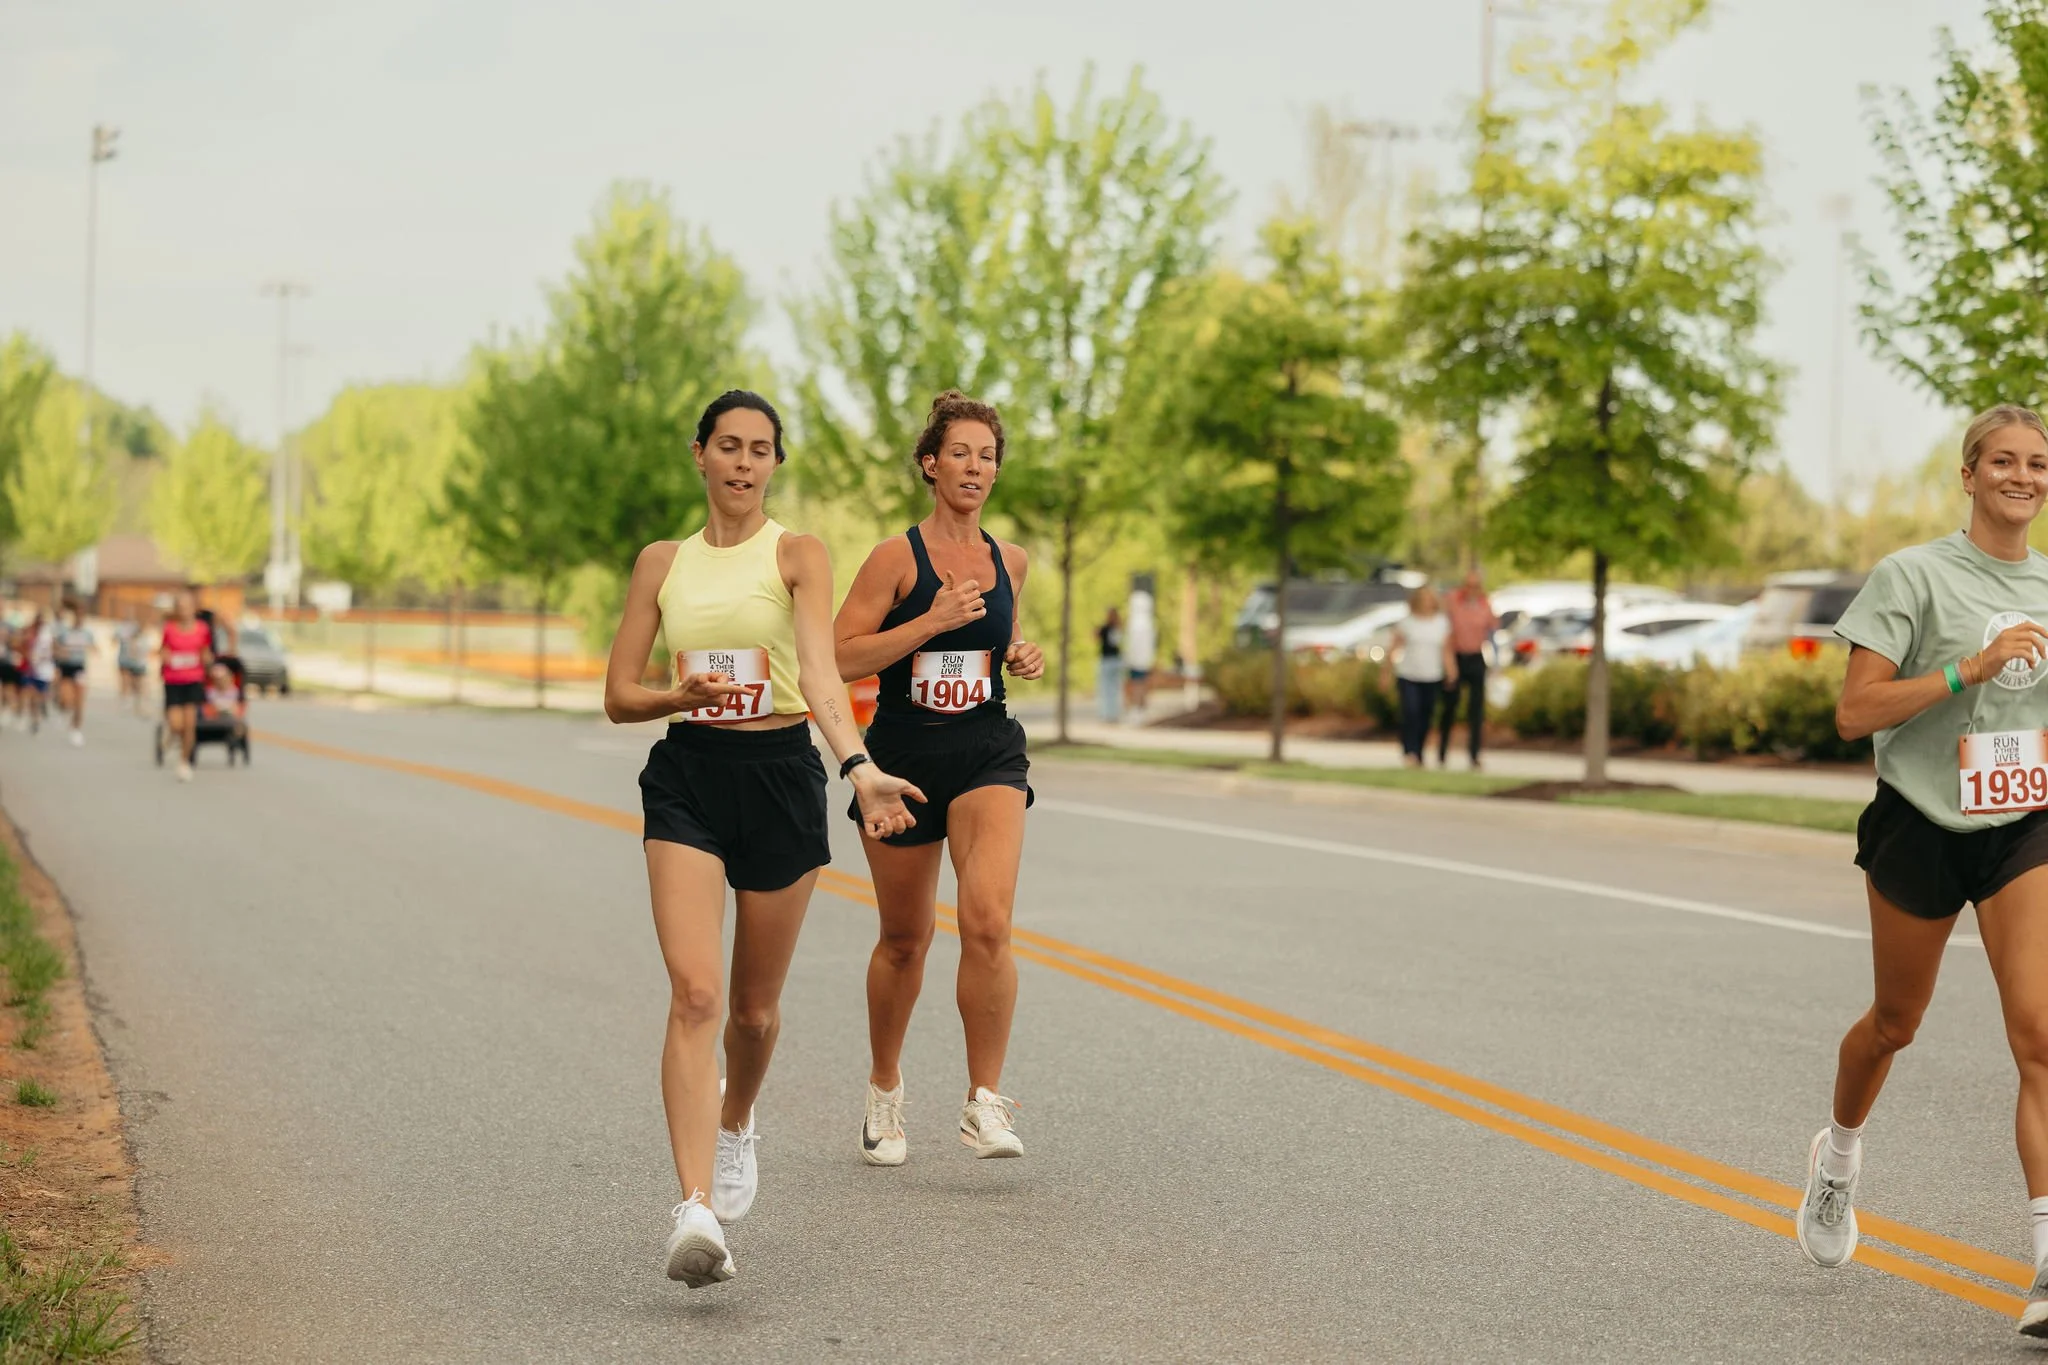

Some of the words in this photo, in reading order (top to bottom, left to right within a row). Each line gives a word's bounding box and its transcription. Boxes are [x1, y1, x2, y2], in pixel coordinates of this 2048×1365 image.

[708, 654, 734, 664] RUN
[942, 655, 965, 664] RUN
[916, 679, 986, 708] 1904
[691, 683, 764, 717] 47
[1993, 736, 2019, 748] RUN
[1995, 753, 2020, 763] LIVES
[1967, 767, 2048, 806] 1939
